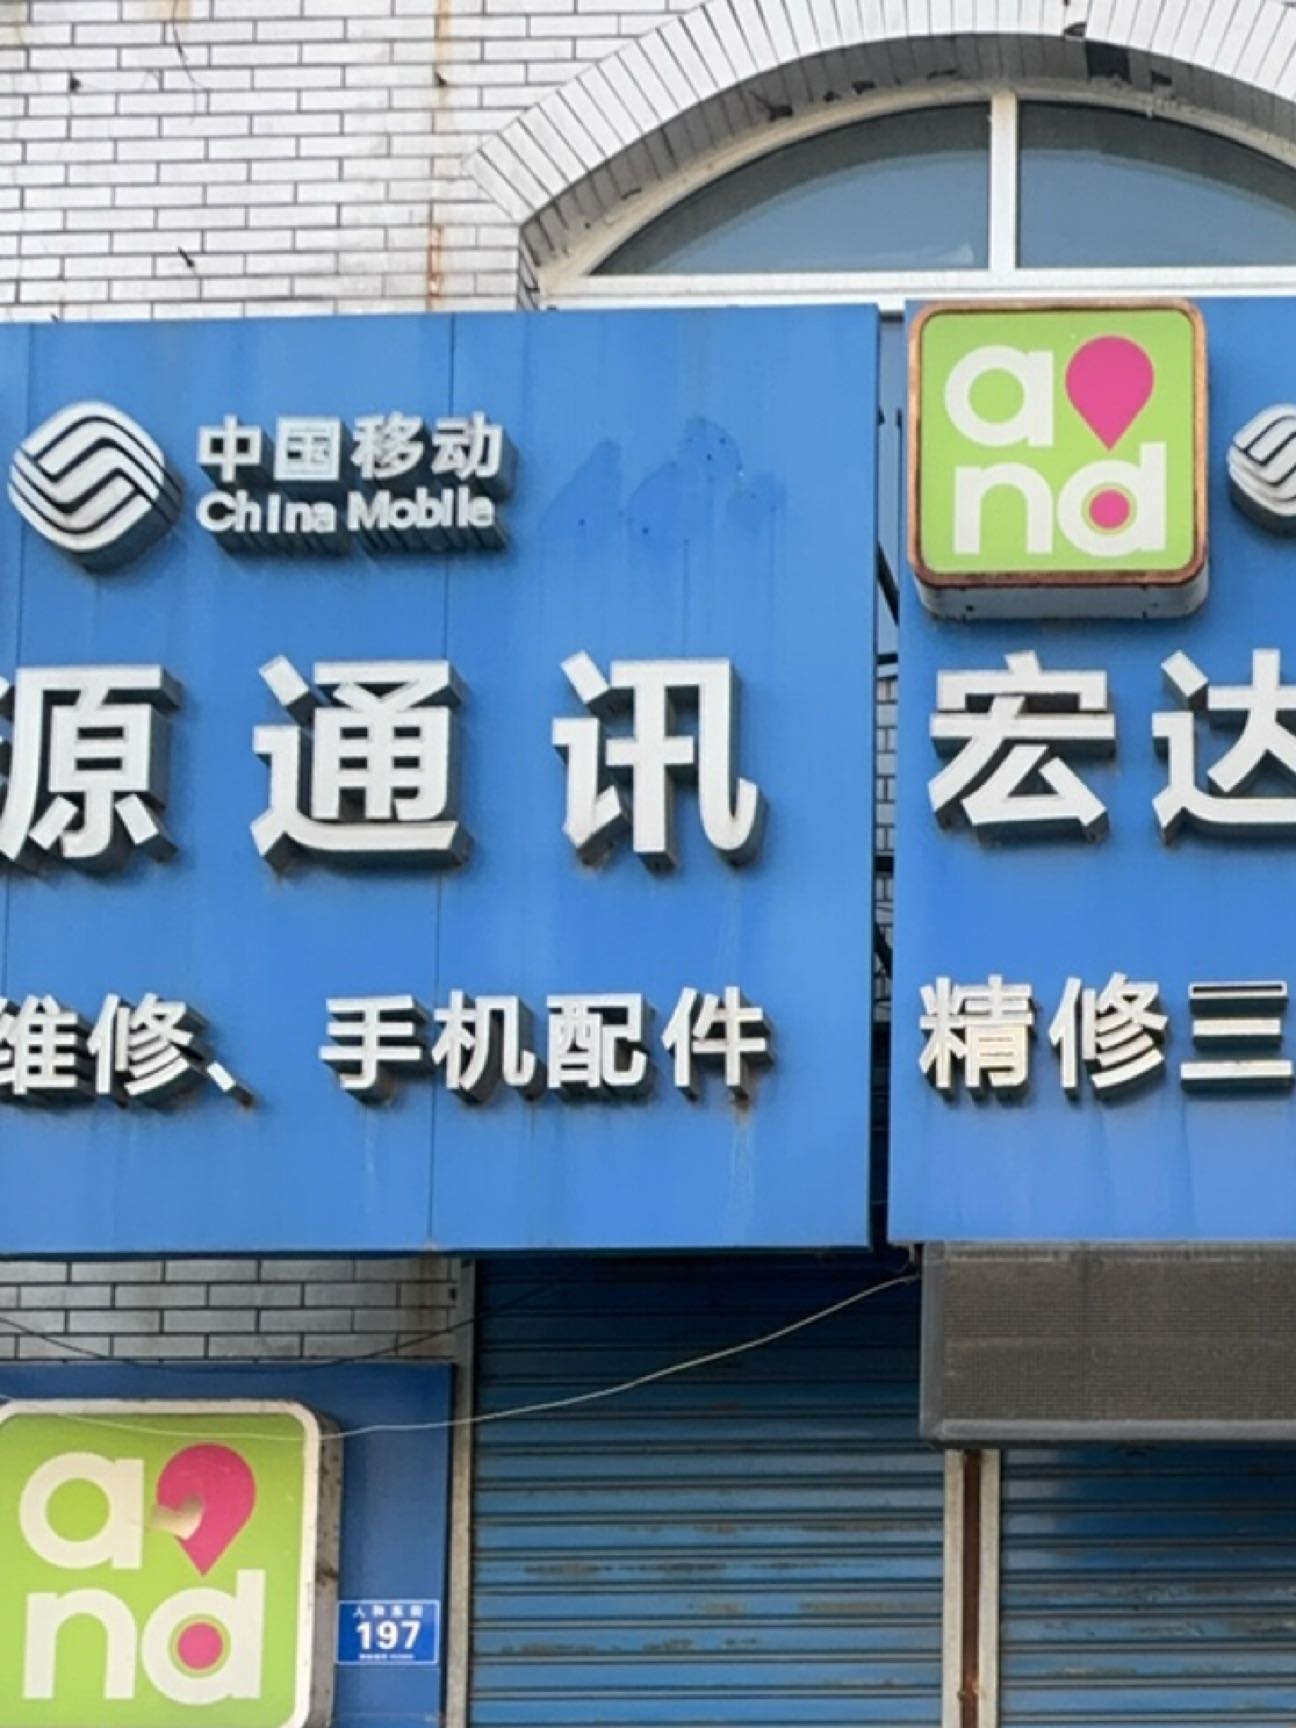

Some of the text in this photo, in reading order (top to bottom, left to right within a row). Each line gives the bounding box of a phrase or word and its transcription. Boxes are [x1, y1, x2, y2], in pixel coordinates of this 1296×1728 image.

[198, 410, 503, 482] 中国移动
[197, 490, 497, 534] China Mobile
[0, 650, 760, 859] 源通讯
[355, 1621, 421, 1650] 197
